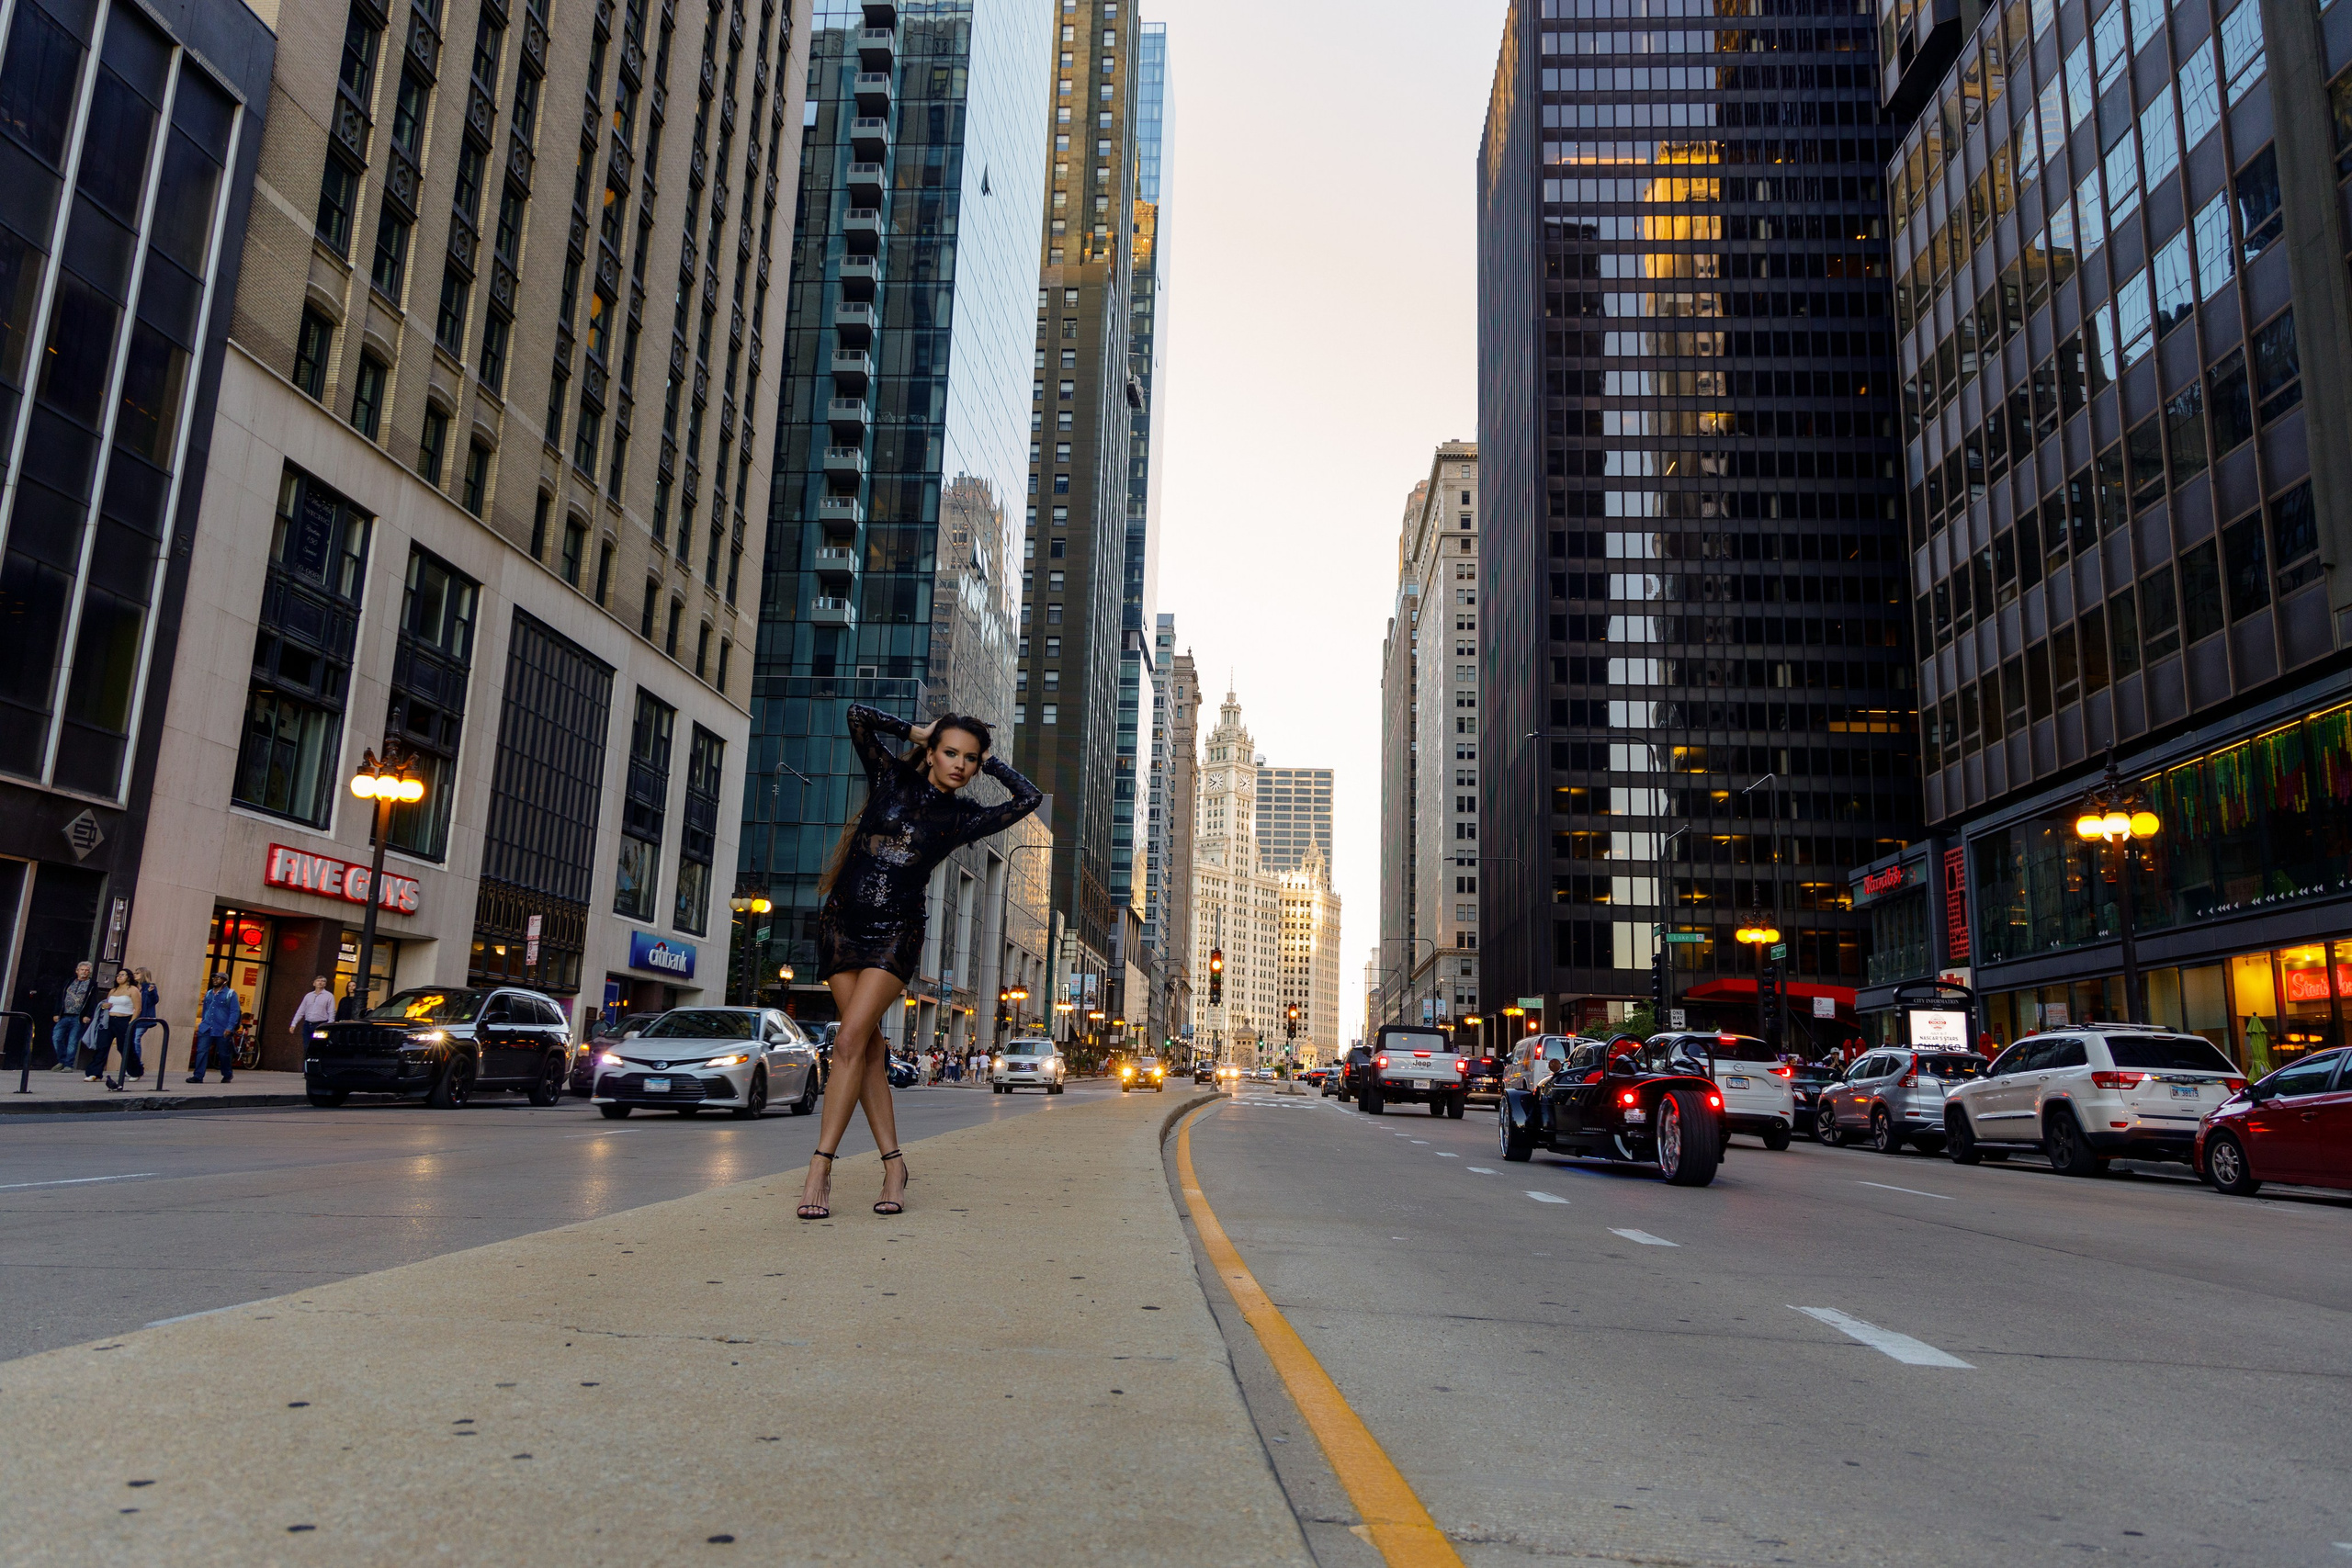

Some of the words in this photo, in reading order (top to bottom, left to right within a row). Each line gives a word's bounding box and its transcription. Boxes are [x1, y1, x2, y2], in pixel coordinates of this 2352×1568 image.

[275, 848, 345, 894] FIVE
[347, 866, 420, 911] GUYS
[649, 944, 687, 973] citibank
[2292, 973, 2329, 998] Stan's
[1413, 1059, 1431, 1067] Jeep
